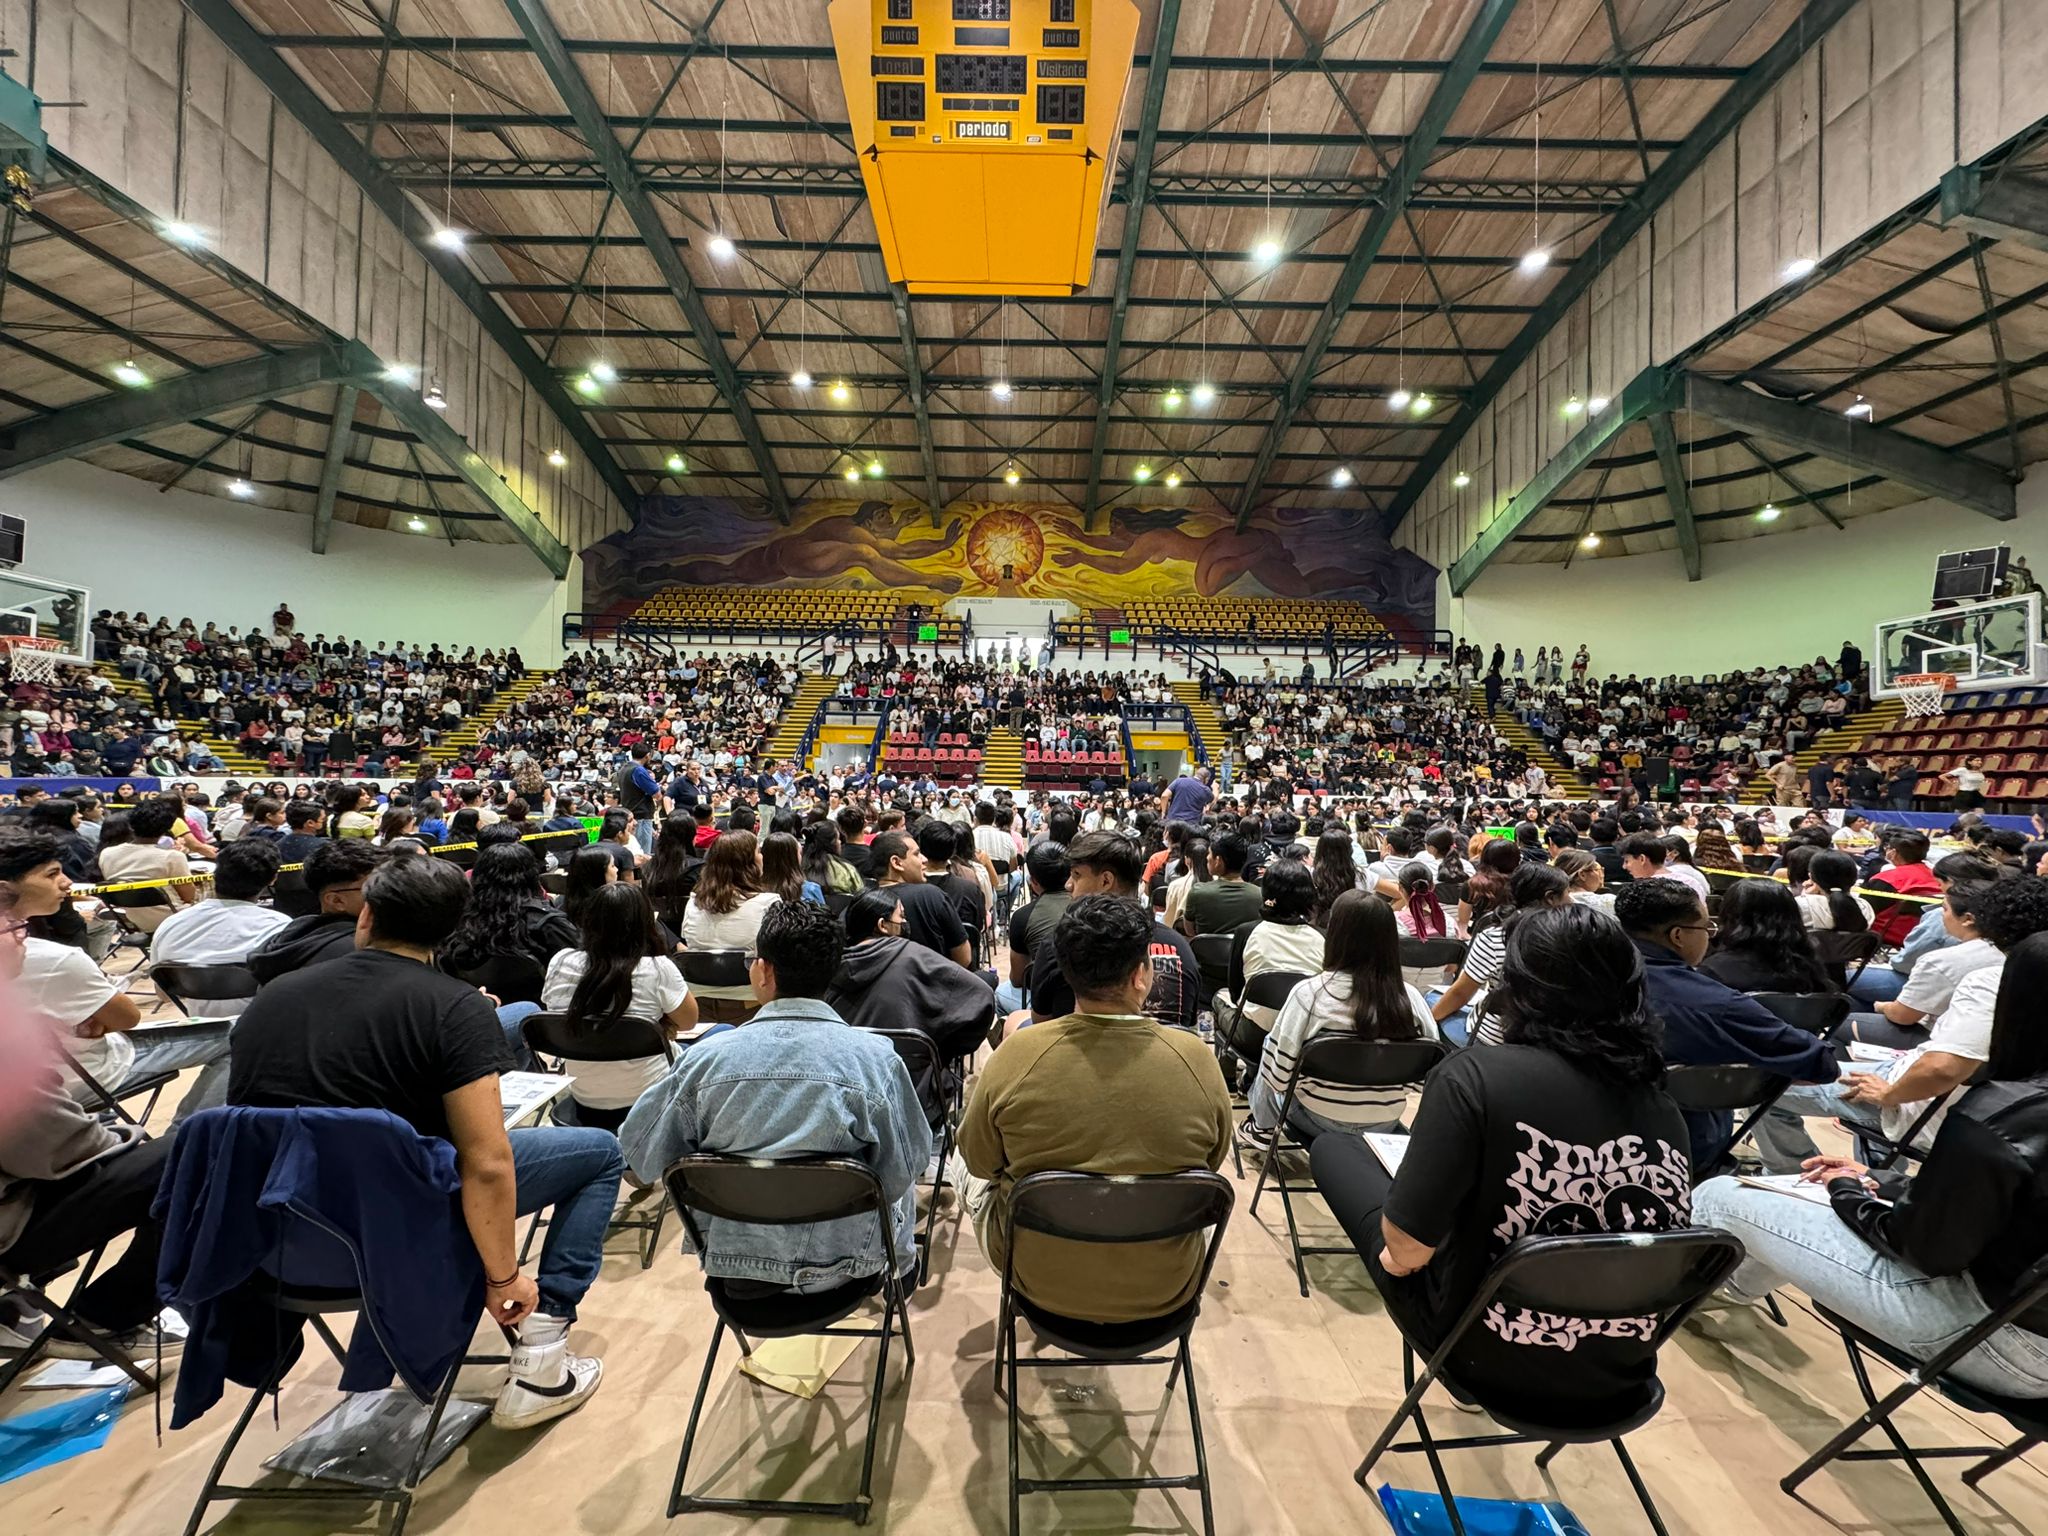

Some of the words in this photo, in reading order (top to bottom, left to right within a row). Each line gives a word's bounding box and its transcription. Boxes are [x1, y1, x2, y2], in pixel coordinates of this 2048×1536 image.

[883, 29, 917, 43] puntos
[1044, 32, 1078, 46] puntos
[879, 57, 914, 74] Local
[1039, 61, 1085, 77] Visitante
[959, 121, 1007, 139] periodo
[1515, 1121, 1648, 1175] TIME
[1656, 1139, 1690, 1183] IS
[1483, 1306, 1658, 1352] MONEY
[513, 1357, 529, 1367] NIKE
